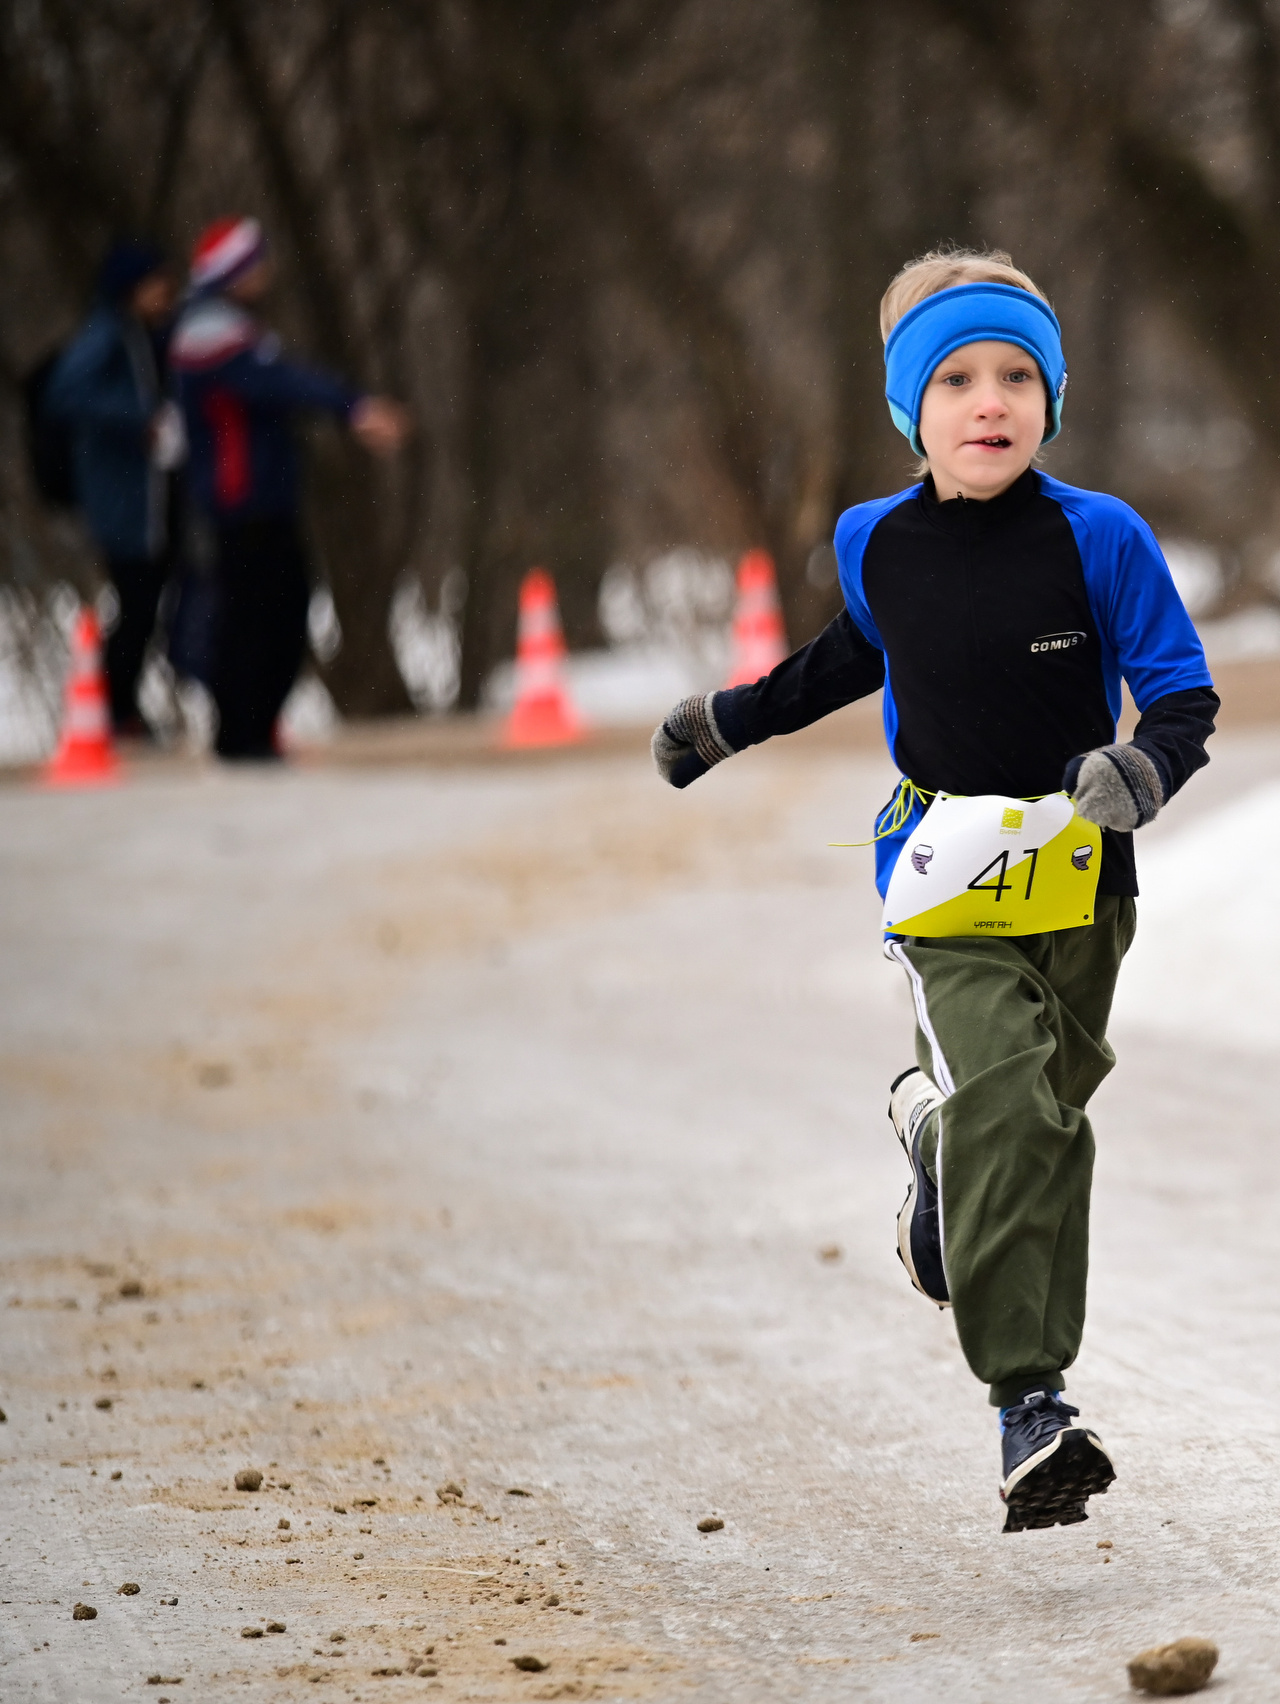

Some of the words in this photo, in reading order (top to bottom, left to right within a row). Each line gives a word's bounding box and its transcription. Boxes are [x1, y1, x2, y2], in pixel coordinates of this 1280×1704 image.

[1030, 636, 1078, 653] COMUS
[967, 848, 1039, 902] 41
[973, 921, 1013, 929] УРАГАН
